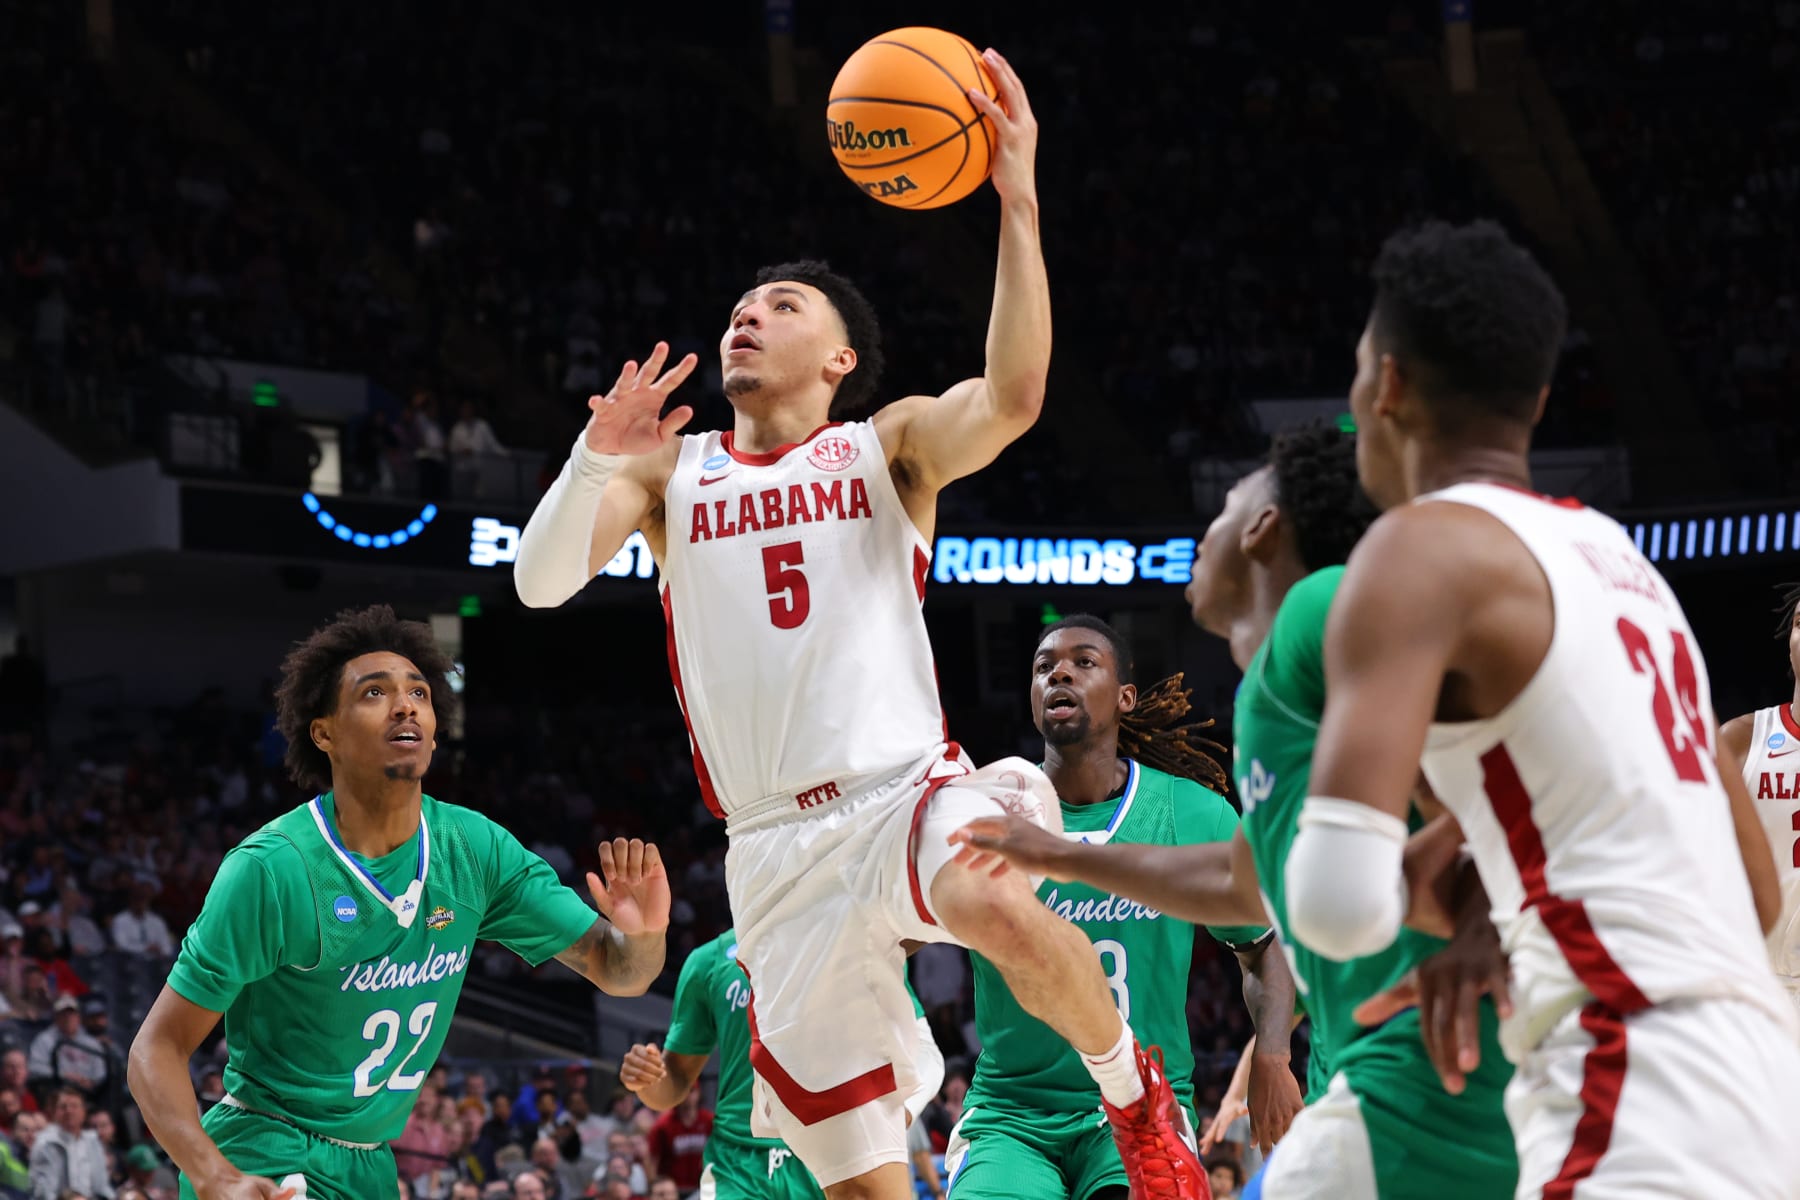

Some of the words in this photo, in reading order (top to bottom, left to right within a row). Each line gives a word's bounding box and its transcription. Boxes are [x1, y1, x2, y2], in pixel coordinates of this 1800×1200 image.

[816, 438, 849, 462] SEC
[690, 478, 872, 543] ALABAMA
[762, 540, 810, 629] 5
[933, 537, 1136, 585] ROUNDS
[1616, 616, 1709, 784] 24
[796, 781, 841, 810] RTR
[337, 907, 357, 916] NCAA
[339, 942, 467, 992] Islanders
[353, 1001, 438, 1097] 22
